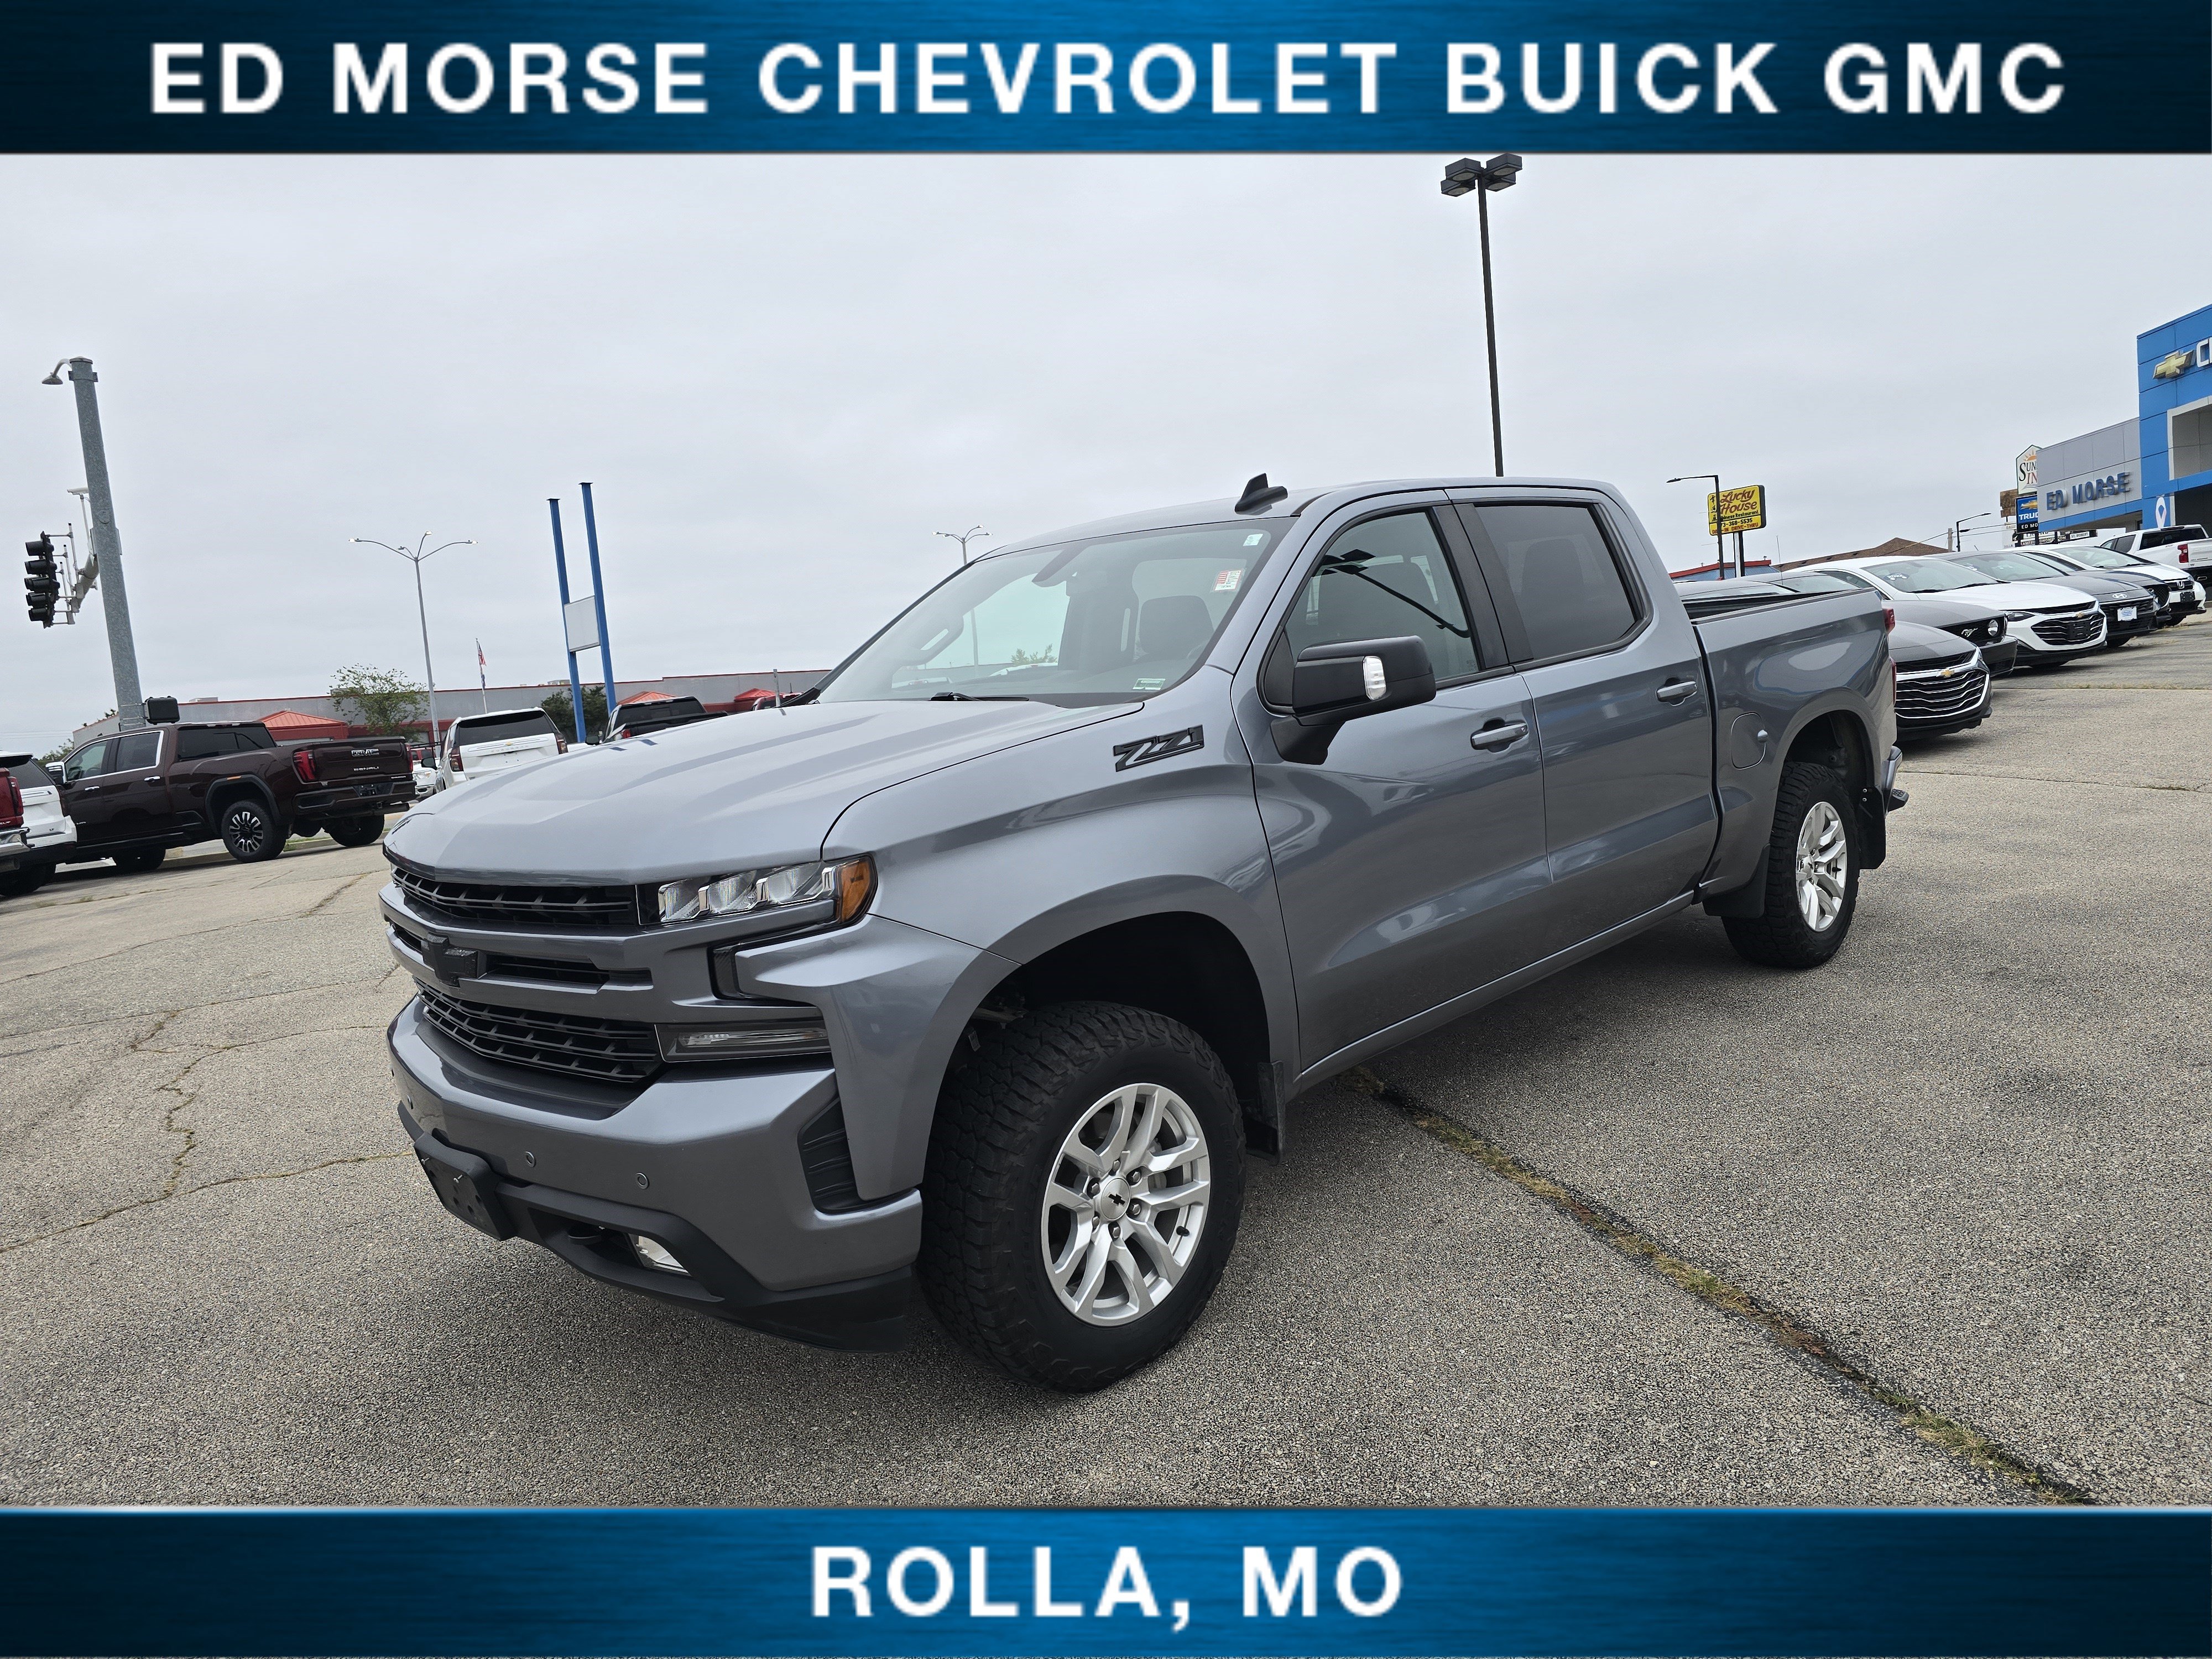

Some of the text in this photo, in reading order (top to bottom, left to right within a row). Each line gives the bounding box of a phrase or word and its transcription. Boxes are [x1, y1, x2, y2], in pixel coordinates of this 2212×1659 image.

[2019, 461, 2037, 481] SUN
[2027, 472, 2037, 484] IN
[1720, 489, 1755, 503] Lucky
[2047, 472, 2128, 510] ED MORSE
[1720, 501, 1757, 515] House
[2018, 512, 2038, 520] TRUC
[351, 748, 379, 757] GMC
[1113, 724, 1205, 773] Z71
